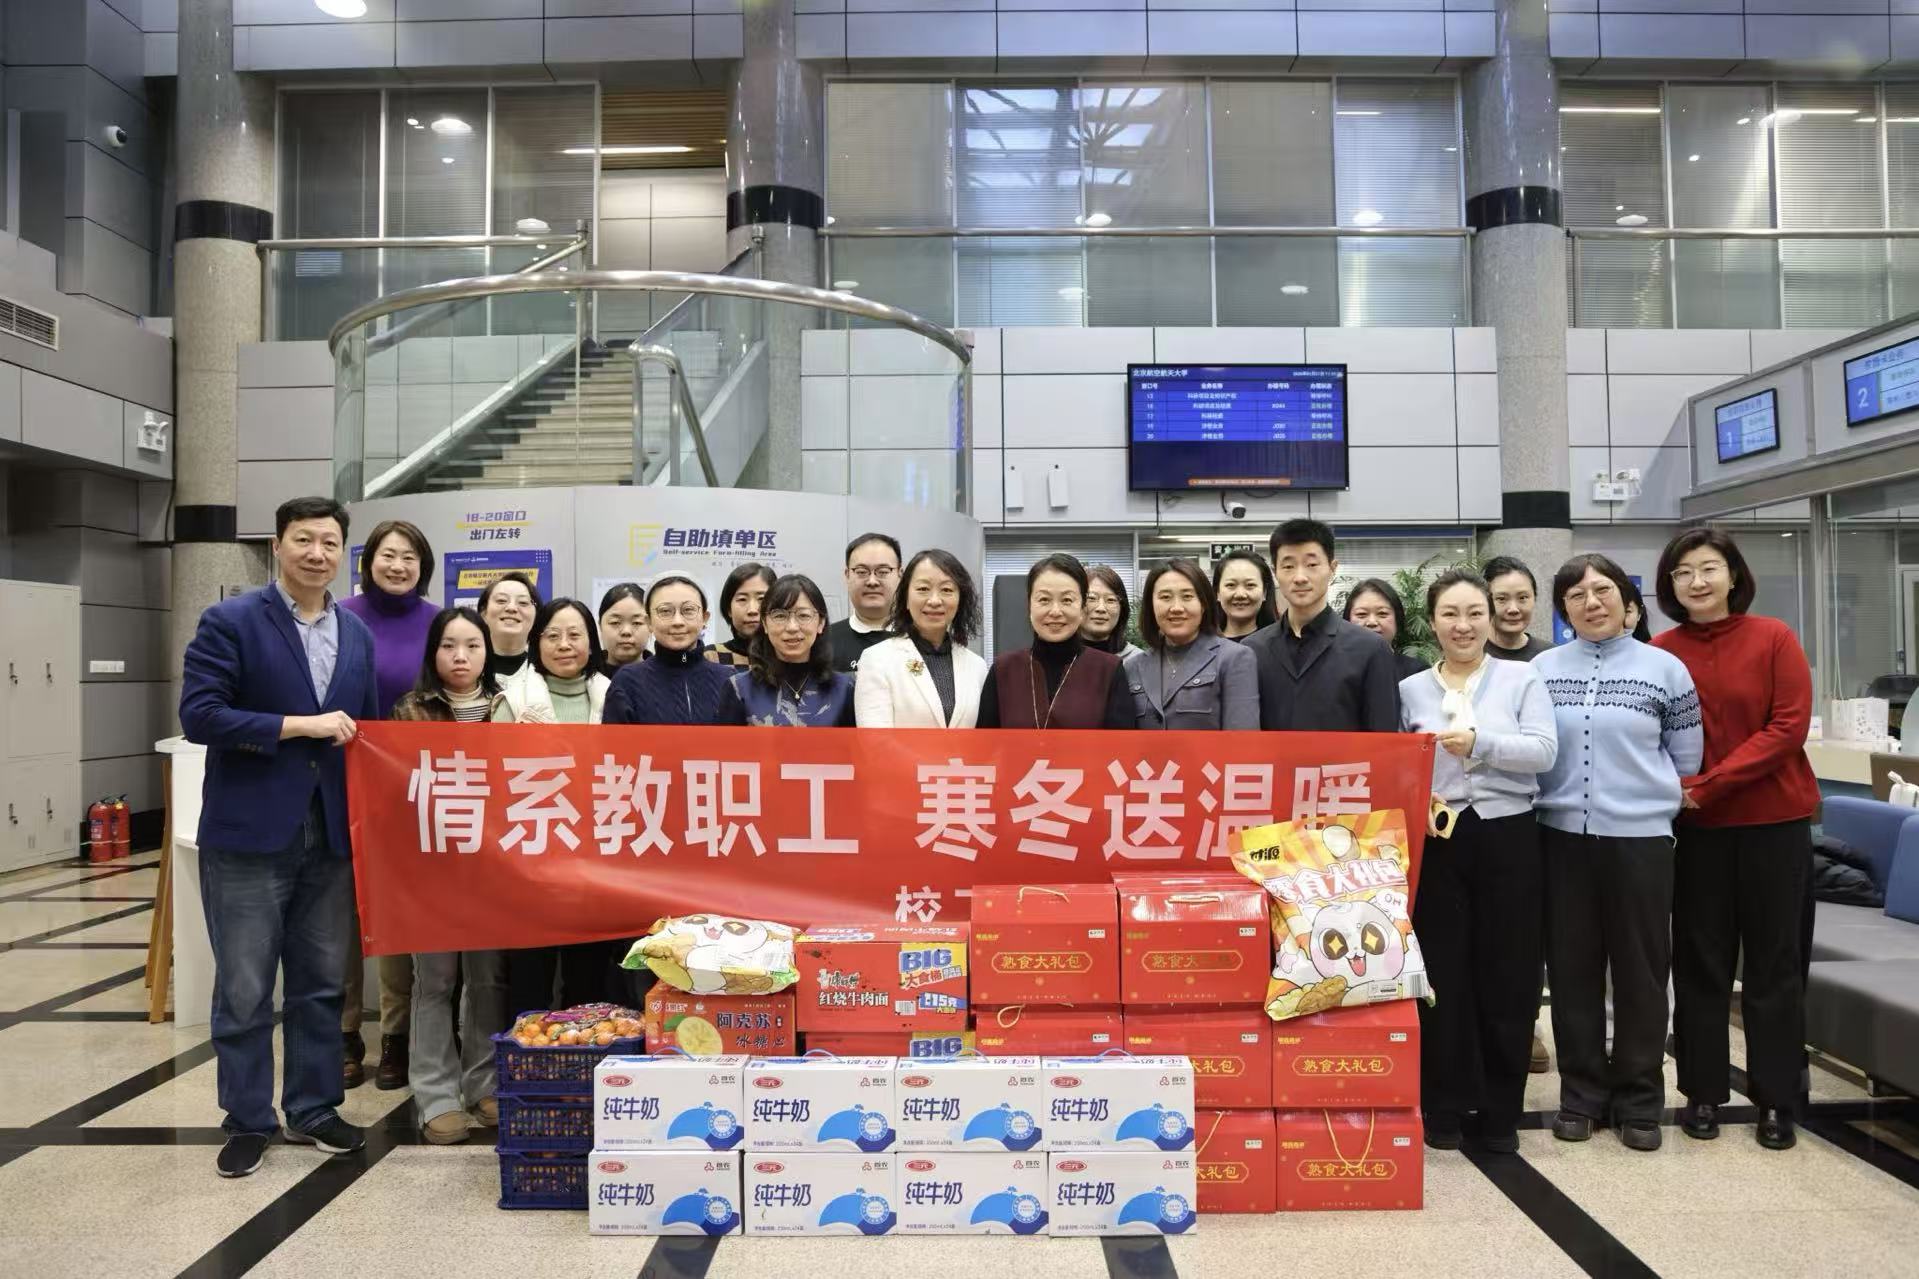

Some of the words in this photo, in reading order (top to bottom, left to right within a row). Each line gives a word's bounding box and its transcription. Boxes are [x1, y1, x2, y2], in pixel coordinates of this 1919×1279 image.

[1858, 387, 1869, 409] 2
[465, 510, 527, 522] 18-20窗口
[469, 528, 521, 540] 出门左转
[663, 528, 777, 549] 自助填单区
[408, 749, 860, 858] 情系教职工
[895, 885, 973, 923] 校
[902, 949, 952, 973] BIG
[1001, 955, 1082, 969] 熟食大礼包
[905, 968, 943, 989] 大食桶
[819, 991, 889, 1006] 红烧牛肉面
[716, 1012, 772, 1029] 阿克苏
[911, 1037, 963, 1057] BIG
[1302, 1059, 1384, 1073] 熟食大礼包
[603, 1096, 660, 1121] 纯牛奶
[753, 1098, 810, 1123] 纯牛奶
[903, 1097, 960, 1121] 纯牛奶
[1050, 1097, 1109, 1121] 纯牛奶
[1306, 1163, 1388, 1177] 熟食大礼包
[598, 1182, 654, 1206] 纯牛奶
[754, 1183, 812, 1207] 纯牛奶
[905, 1181, 963, 1205] 纯牛奶
[1057, 1182, 1115, 1206] 纯牛奶
